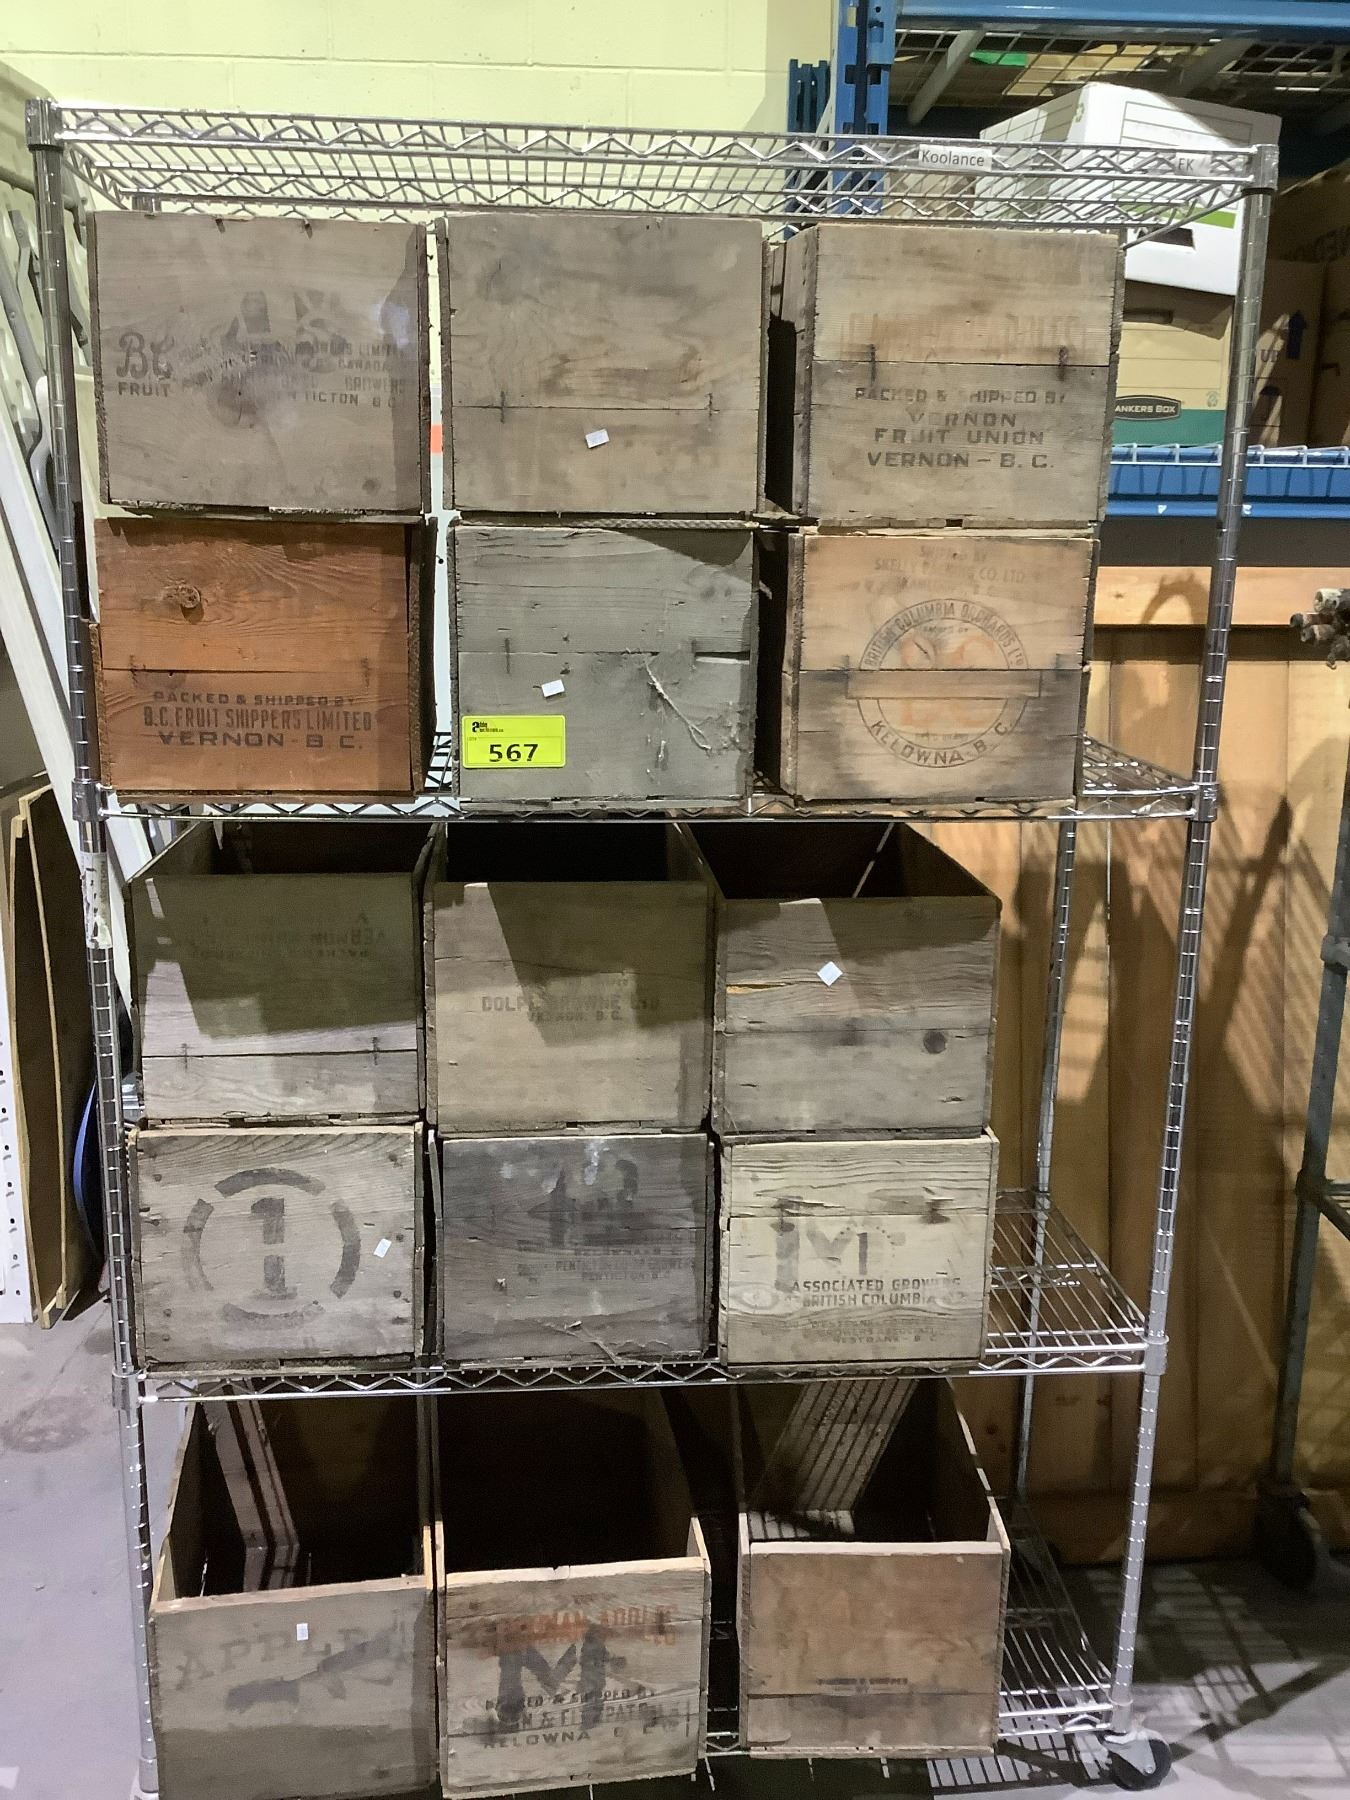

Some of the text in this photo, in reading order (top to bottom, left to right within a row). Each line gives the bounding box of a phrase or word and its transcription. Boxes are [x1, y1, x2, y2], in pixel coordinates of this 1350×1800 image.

[921, 150, 985, 167] Koolance
[117, 382, 171, 397] FRUIT
[1156, 404, 1176, 413] BOX
[909, 412, 1017, 428] VRNON
[875, 428, 1044, 445] FRUIT UNION
[867, 452, 969, 468] VERNON
[898, 601, 955, 632] COLUMBIA
[153, 691, 229, 704] PACKED
[175, 707, 219, 728] FRUIT
[226, 708, 301, 730] SHIPPERS
[306, 709, 372, 731] LIMITED
[159, 730, 284, 747] VERNON
[870, 720, 965, 765] KELOWNA
[489, 743, 538, 763] 567
[793, 1279, 884, 1293] ASSOCIATED
[803, 1293, 857, 1307] BRITISH
